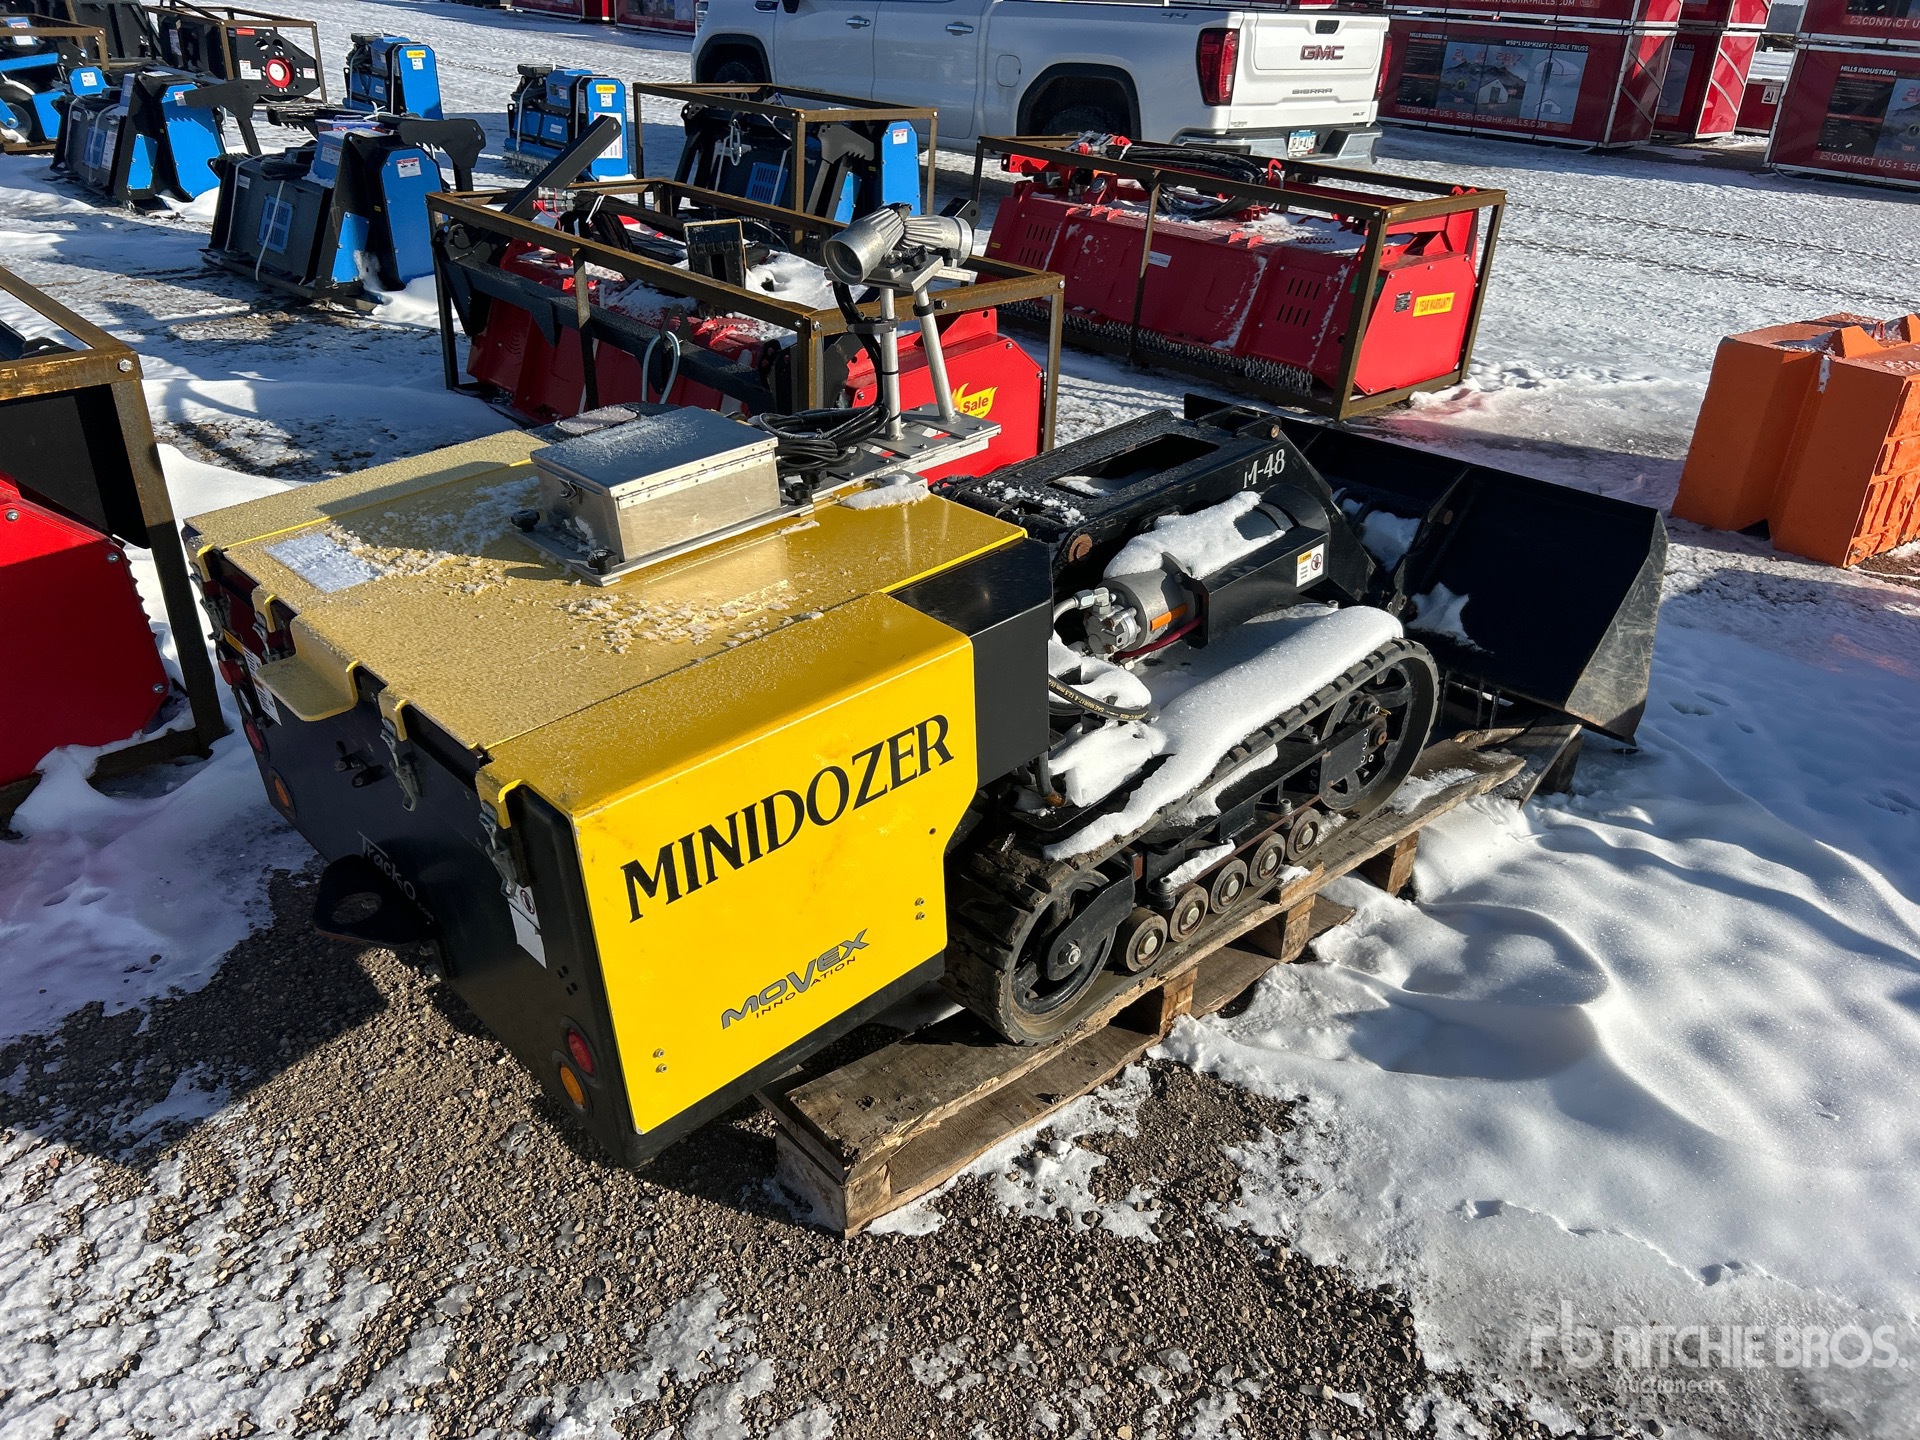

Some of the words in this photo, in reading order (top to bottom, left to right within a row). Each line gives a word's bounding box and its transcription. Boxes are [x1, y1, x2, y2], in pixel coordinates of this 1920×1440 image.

[1862, 16, 1910, 27] CONTACT
[1300, 45, 1345, 61] GMC
[1571, 44, 1589, 52] TRUSS
[1858, 66, 1897, 76] INDUSTRIAL
[1406, 106, 1438, 117] CONTACT
[1830, 153, 1876, 166] CONTACT
[1878, 159, 1898, 169] US:
[963, 397, 989, 413] Sale
[620, 714, 954, 923] MINIDOZER
[721, 928, 870, 1030] MOVEX
